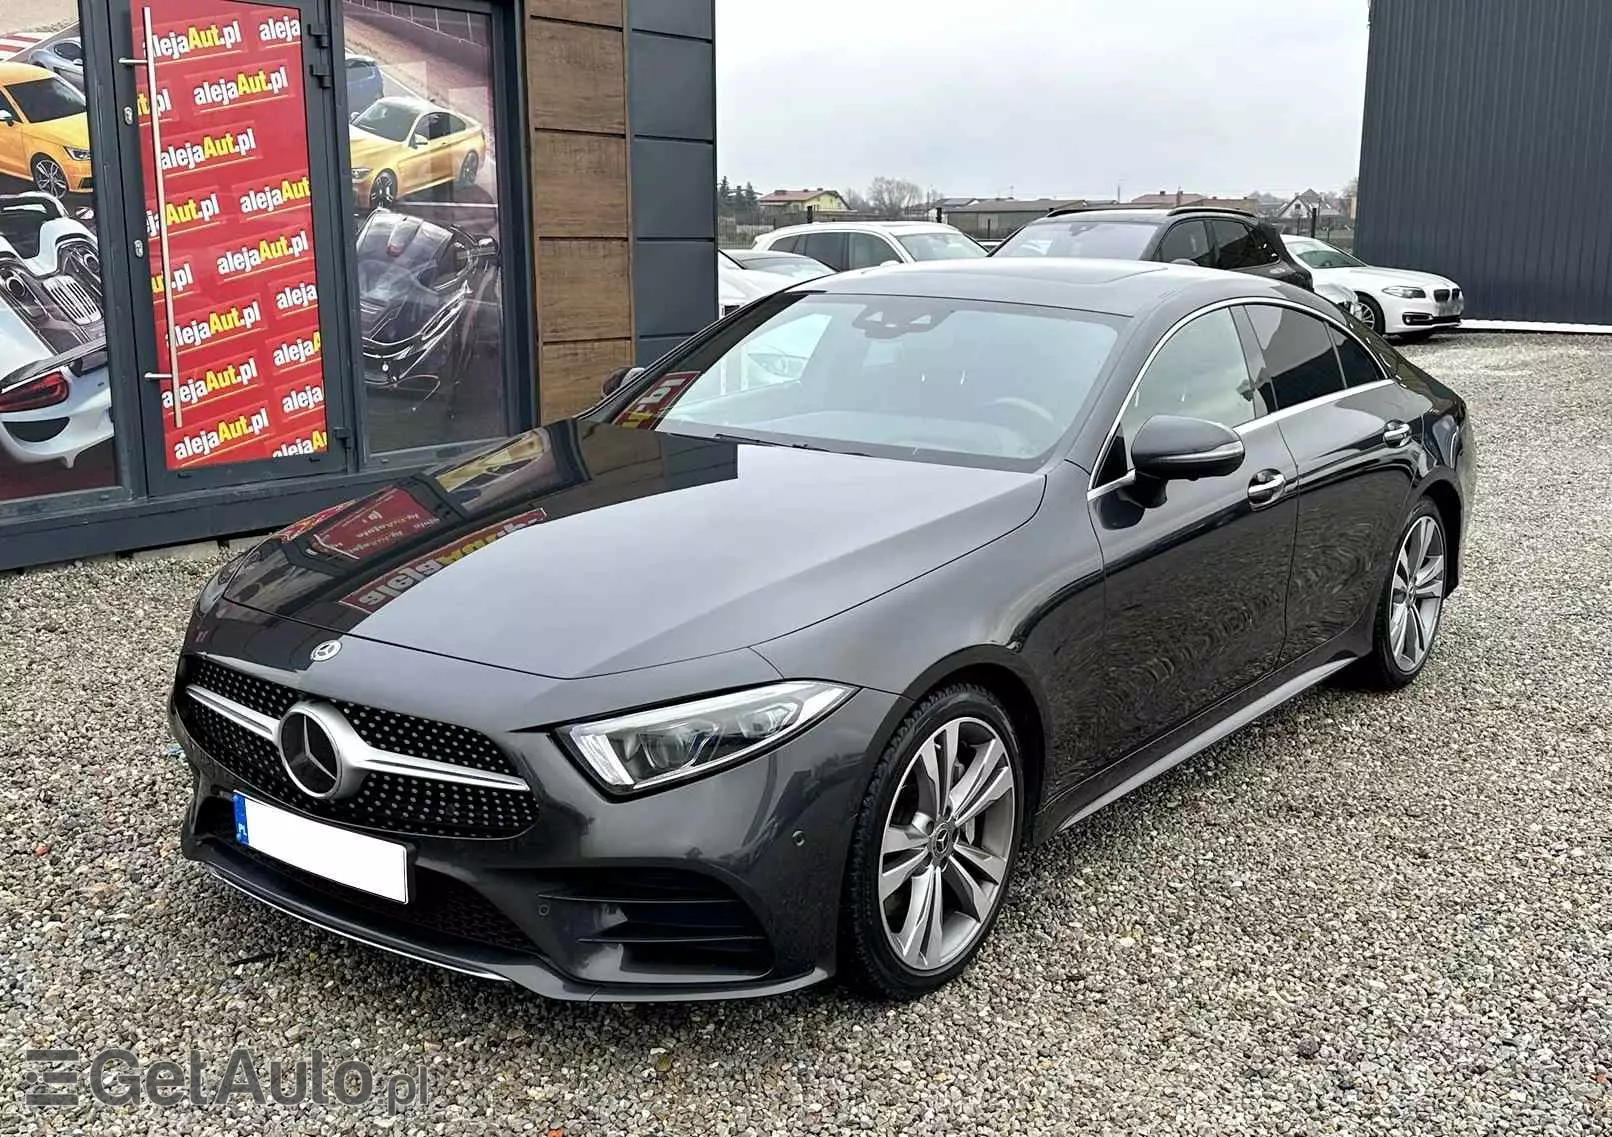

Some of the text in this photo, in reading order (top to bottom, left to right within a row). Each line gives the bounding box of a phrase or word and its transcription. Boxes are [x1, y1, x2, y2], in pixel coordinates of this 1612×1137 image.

[193, 66, 288, 105] alejaAut.pl
[160, 128, 256, 170] alejaAut.pl
[217, 231, 309, 275] alejaAut.pl
[276, 282, 317, 310] aleja
[162, 358, 257, 409] aejaAut.pl
[283, 386, 322, 413] aleja
[174, 408, 269, 460] alejaAut.pl
[238, 823, 247, 836] PL
